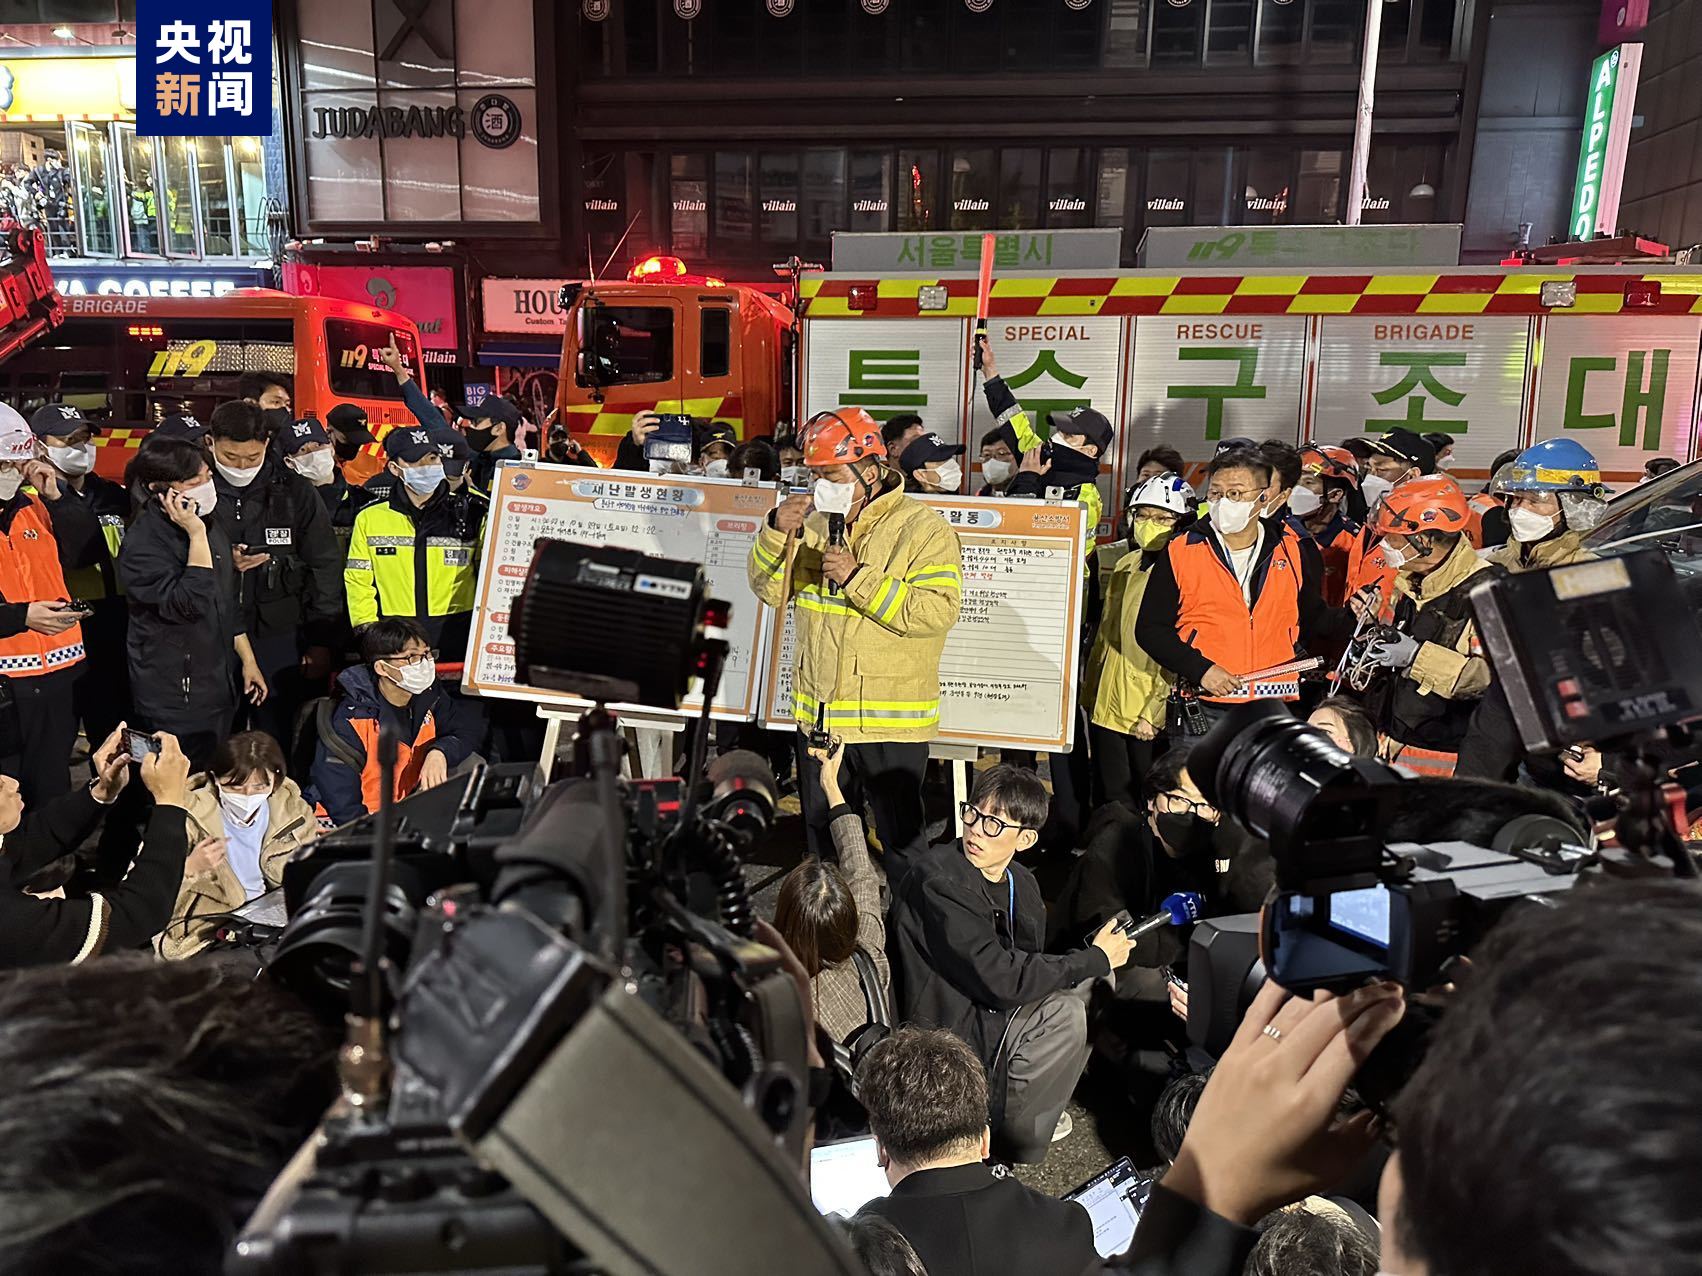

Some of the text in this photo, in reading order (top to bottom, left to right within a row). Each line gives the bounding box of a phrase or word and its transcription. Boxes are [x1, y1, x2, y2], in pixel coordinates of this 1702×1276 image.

[312, 105, 466, 139] JUDABANG
[485, 113, 504, 130] 酒
[584, 199, 618, 211] villain
[673, 200, 706, 211] villain
[762, 200, 796, 211] villain
[853, 200, 888, 211] villain
[953, 199, 989, 210] villain
[1049, 199, 1086, 210] villain
[1146, 198, 1184, 210] villain
[1246, 198, 1286, 210] villain
[897, 233, 1053, 267] 서울특별시
[72, 300, 149, 314] BRIGADE
[525, 317, 554, 326] Custom
[1004, 323, 1475, 342] SPECIAL RESCUE BRIGADE
[146, 339, 218, 377] 119
[340, 344, 368, 369] 119
[466, 386, 486, 396] BIG
[466, 396, 486, 407] SIZ
